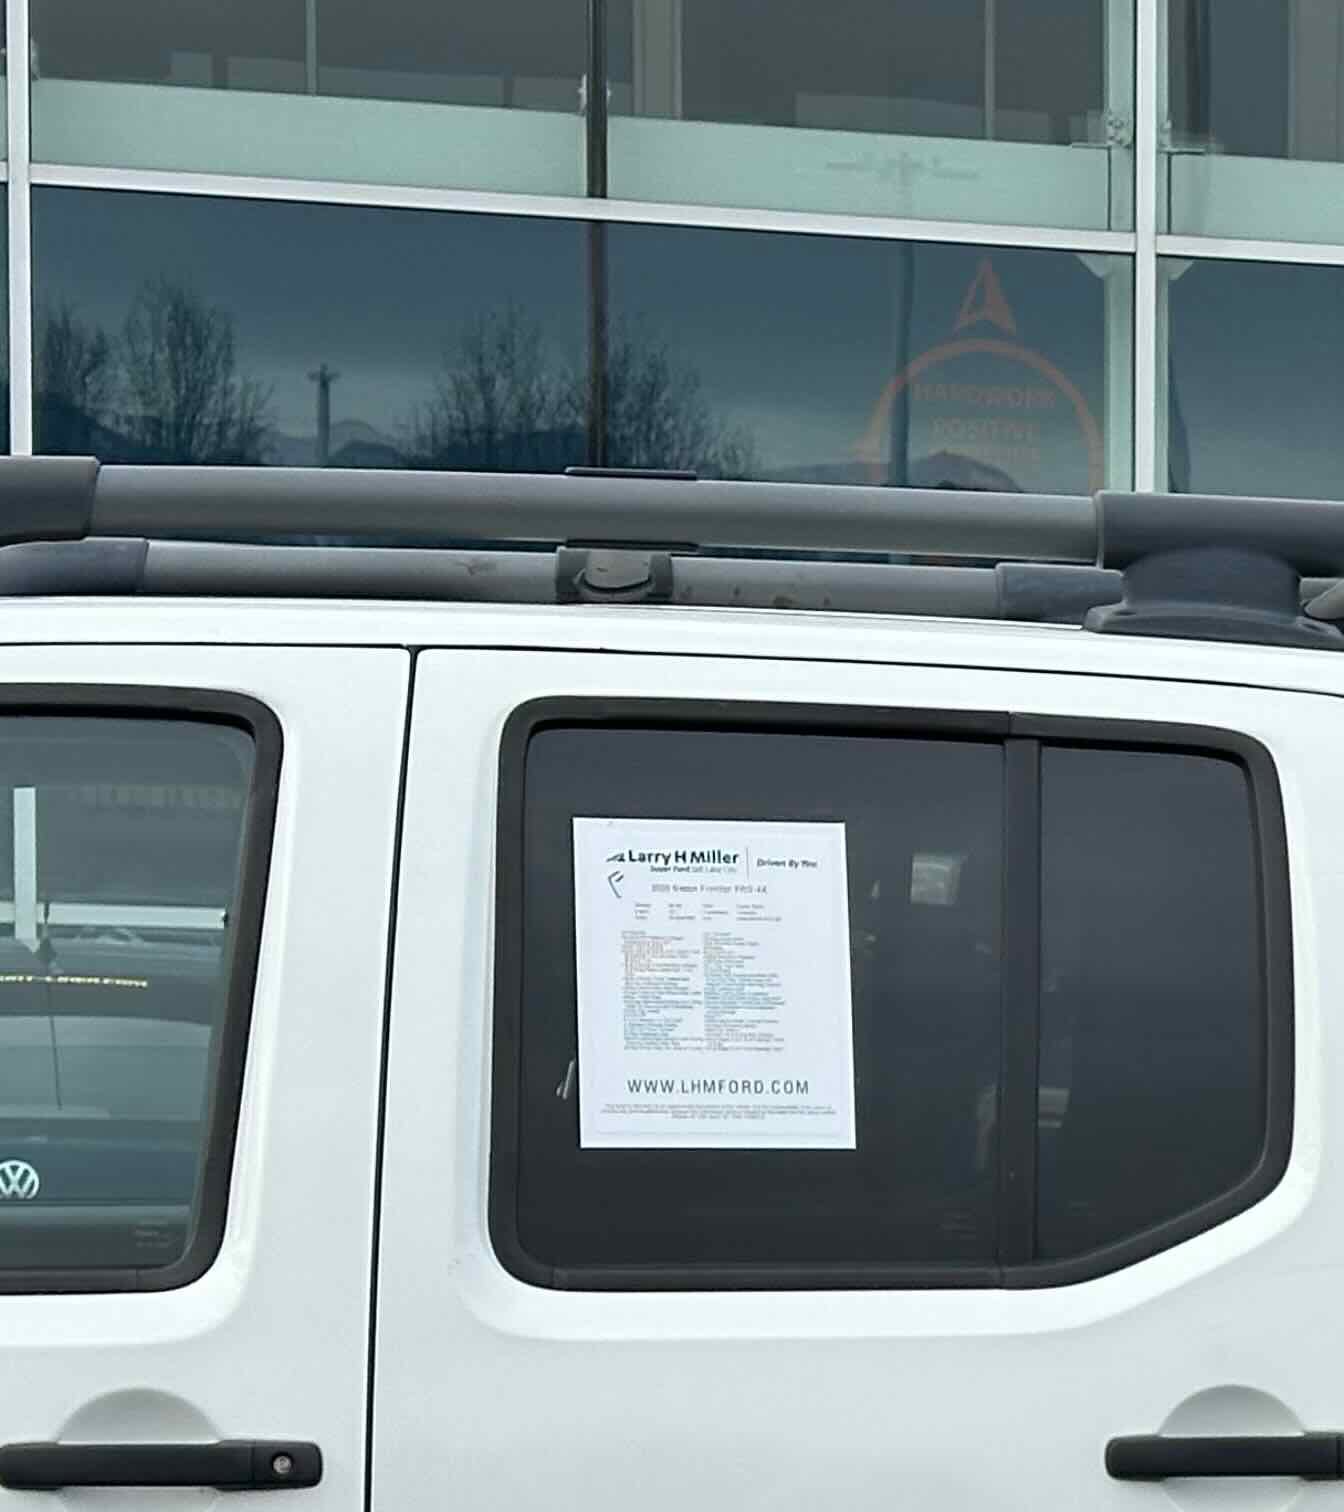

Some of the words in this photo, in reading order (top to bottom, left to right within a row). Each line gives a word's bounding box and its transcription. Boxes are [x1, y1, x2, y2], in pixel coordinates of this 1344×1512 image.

[628, 850, 672, 866] Larry
[675, 850, 687, 864] H
[690, 850, 740, 865] Miller
[627, 1079, 810, 1095] WWW.LHMFORD.COM
